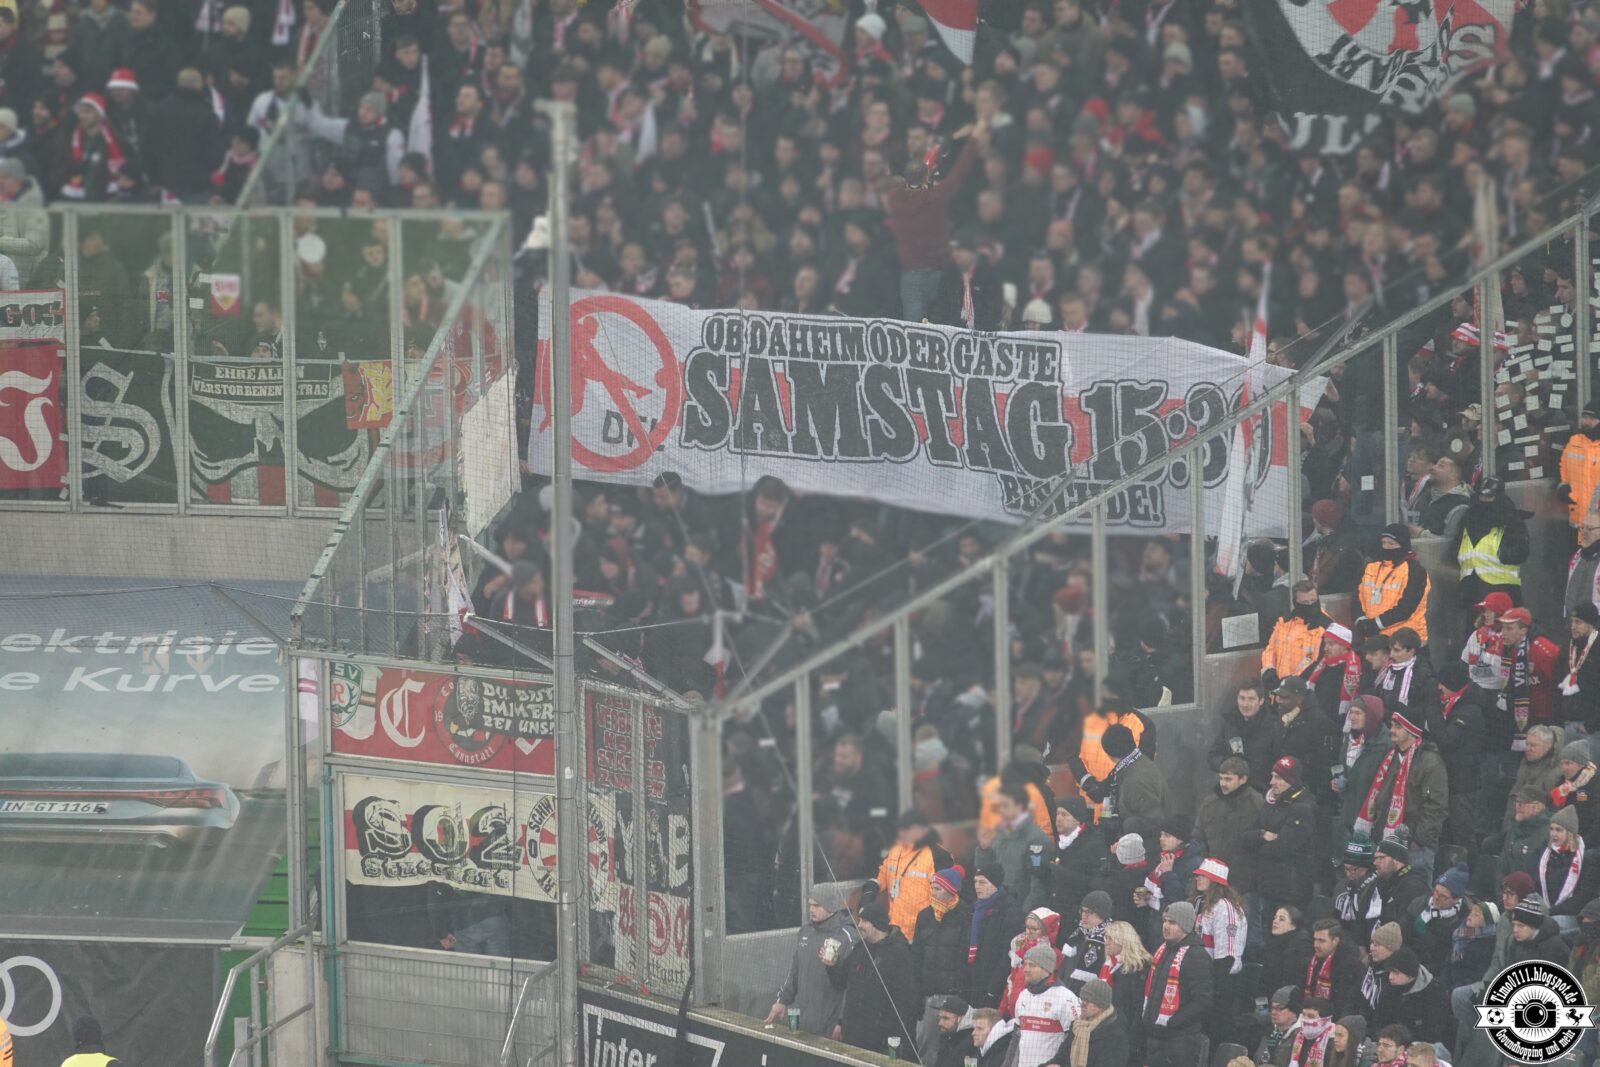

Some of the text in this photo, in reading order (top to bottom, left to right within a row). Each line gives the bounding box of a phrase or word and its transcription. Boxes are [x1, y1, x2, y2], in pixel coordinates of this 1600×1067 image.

[705, 316, 1059, 383] OB DAHEIM ODER GÄSTE
[215, 366, 304, 380] EHRE ALLN
[684, 350, 1070, 480] SAMSTAG
[482, 699, 555, 721] IMMER
[482, 714, 511, 732] BEI
[4, 801, 25, 812] IN
[34, 802, 58, 813] GT
